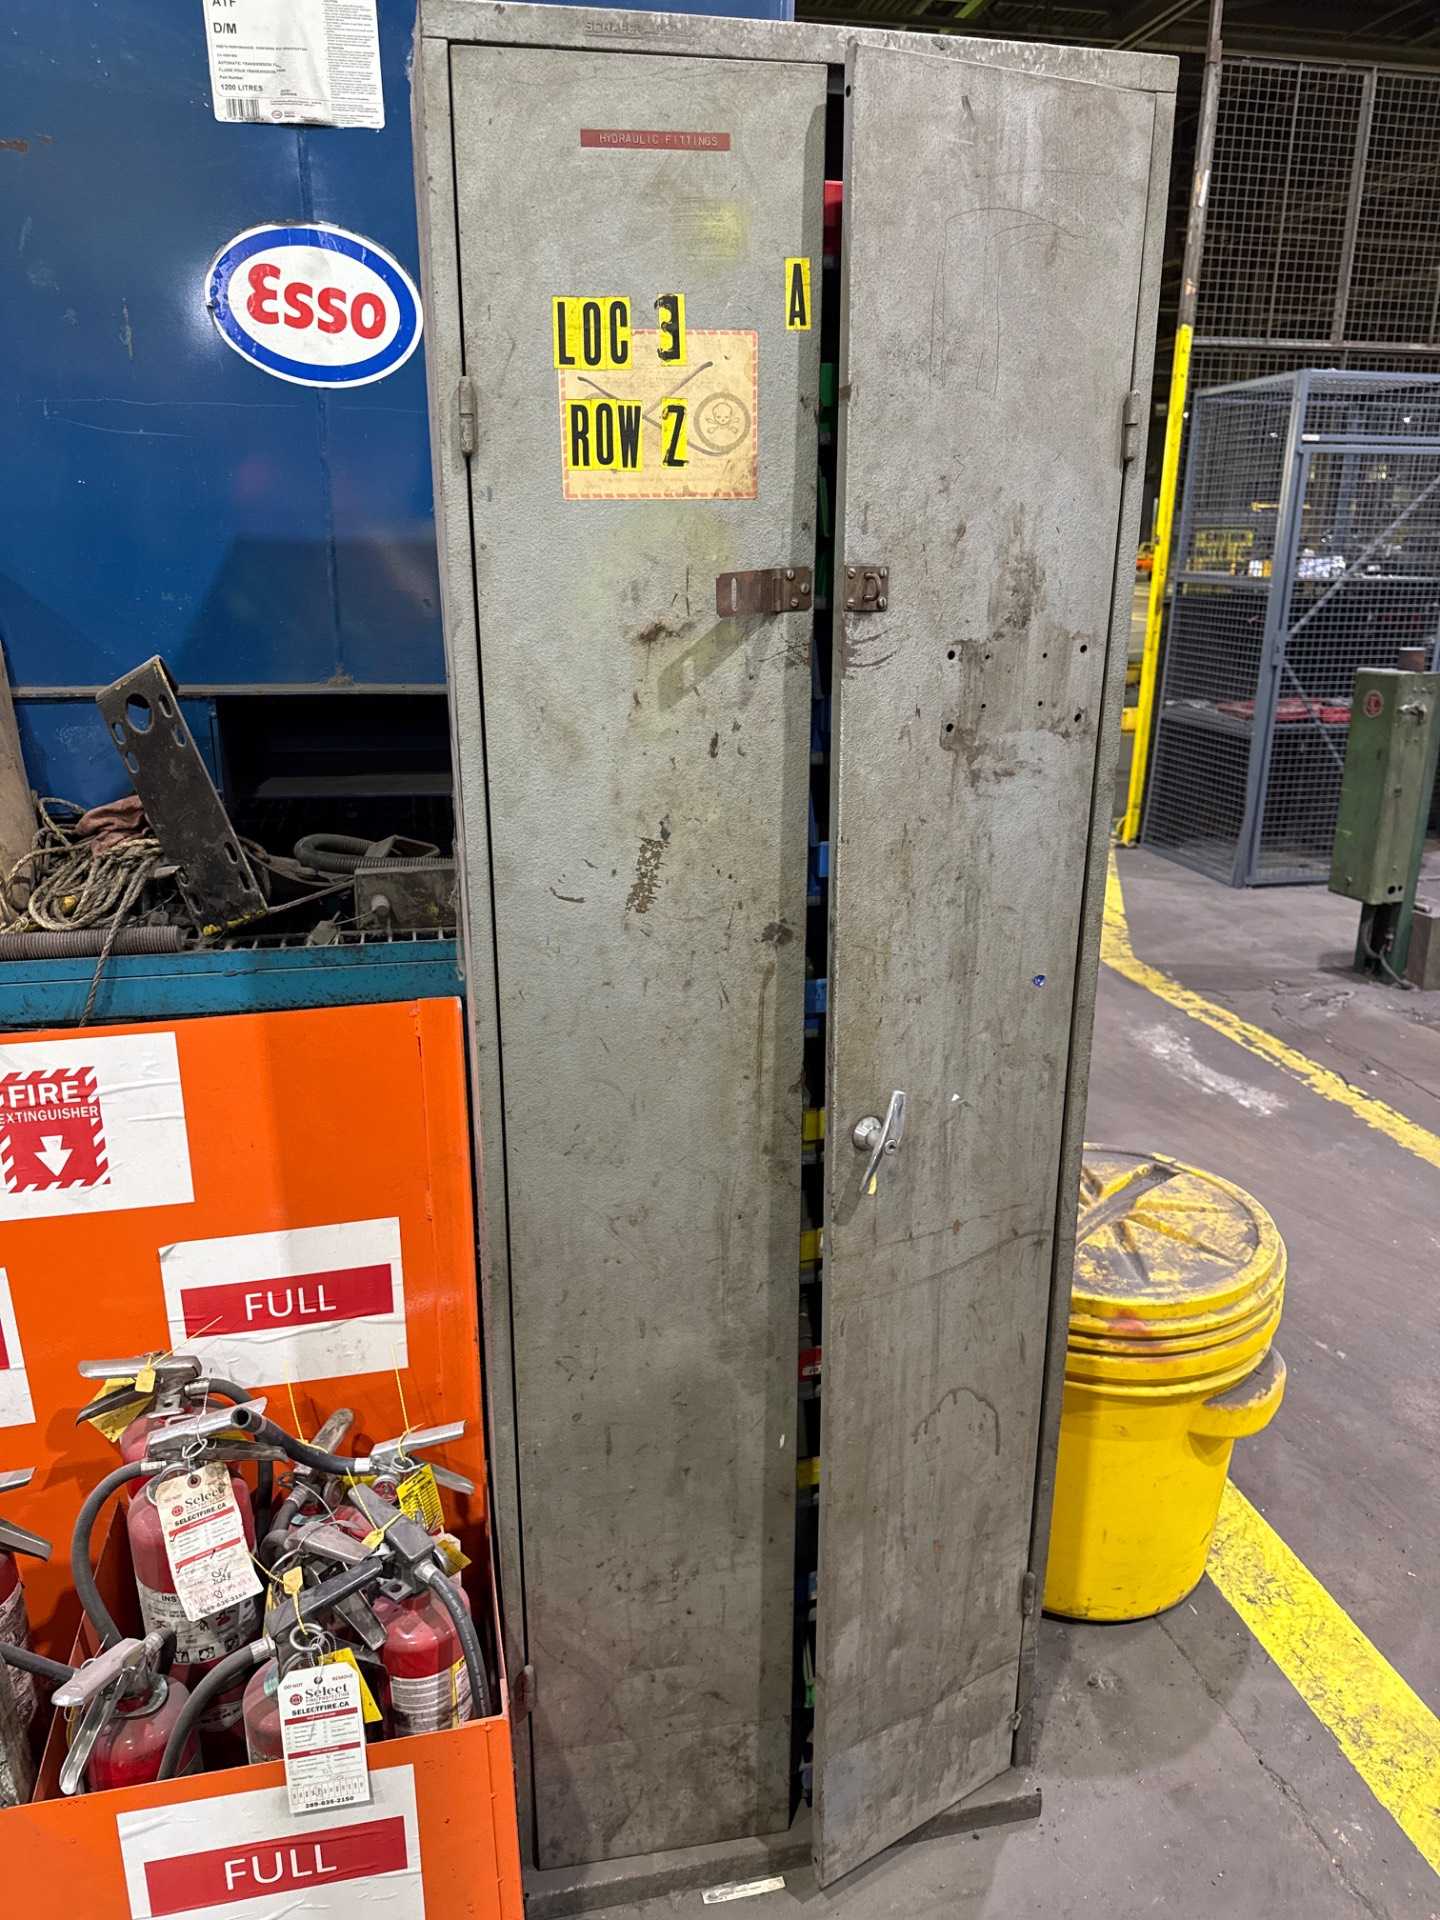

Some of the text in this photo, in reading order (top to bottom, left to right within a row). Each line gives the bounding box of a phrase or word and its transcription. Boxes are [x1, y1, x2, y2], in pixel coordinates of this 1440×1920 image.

[213, 23, 237, 34] D/M
[238, 84, 263, 92] LITRES
[600, 134, 719, 146] HYDRAULIC FITTINGS
[789, 263, 807, 326] A
[557, 294, 681, 365] LOC 3
[571, 403, 689, 468] ROW 2
[8, 1080, 82, 1109] FIRE
[245, 1285, 337, 1321] FULL
[305, 1683, 347, 1698] Select
[292, 1701, 350, 1716] SELECTFIRE.CA
[224, 1844, 337, 1890] FULL
